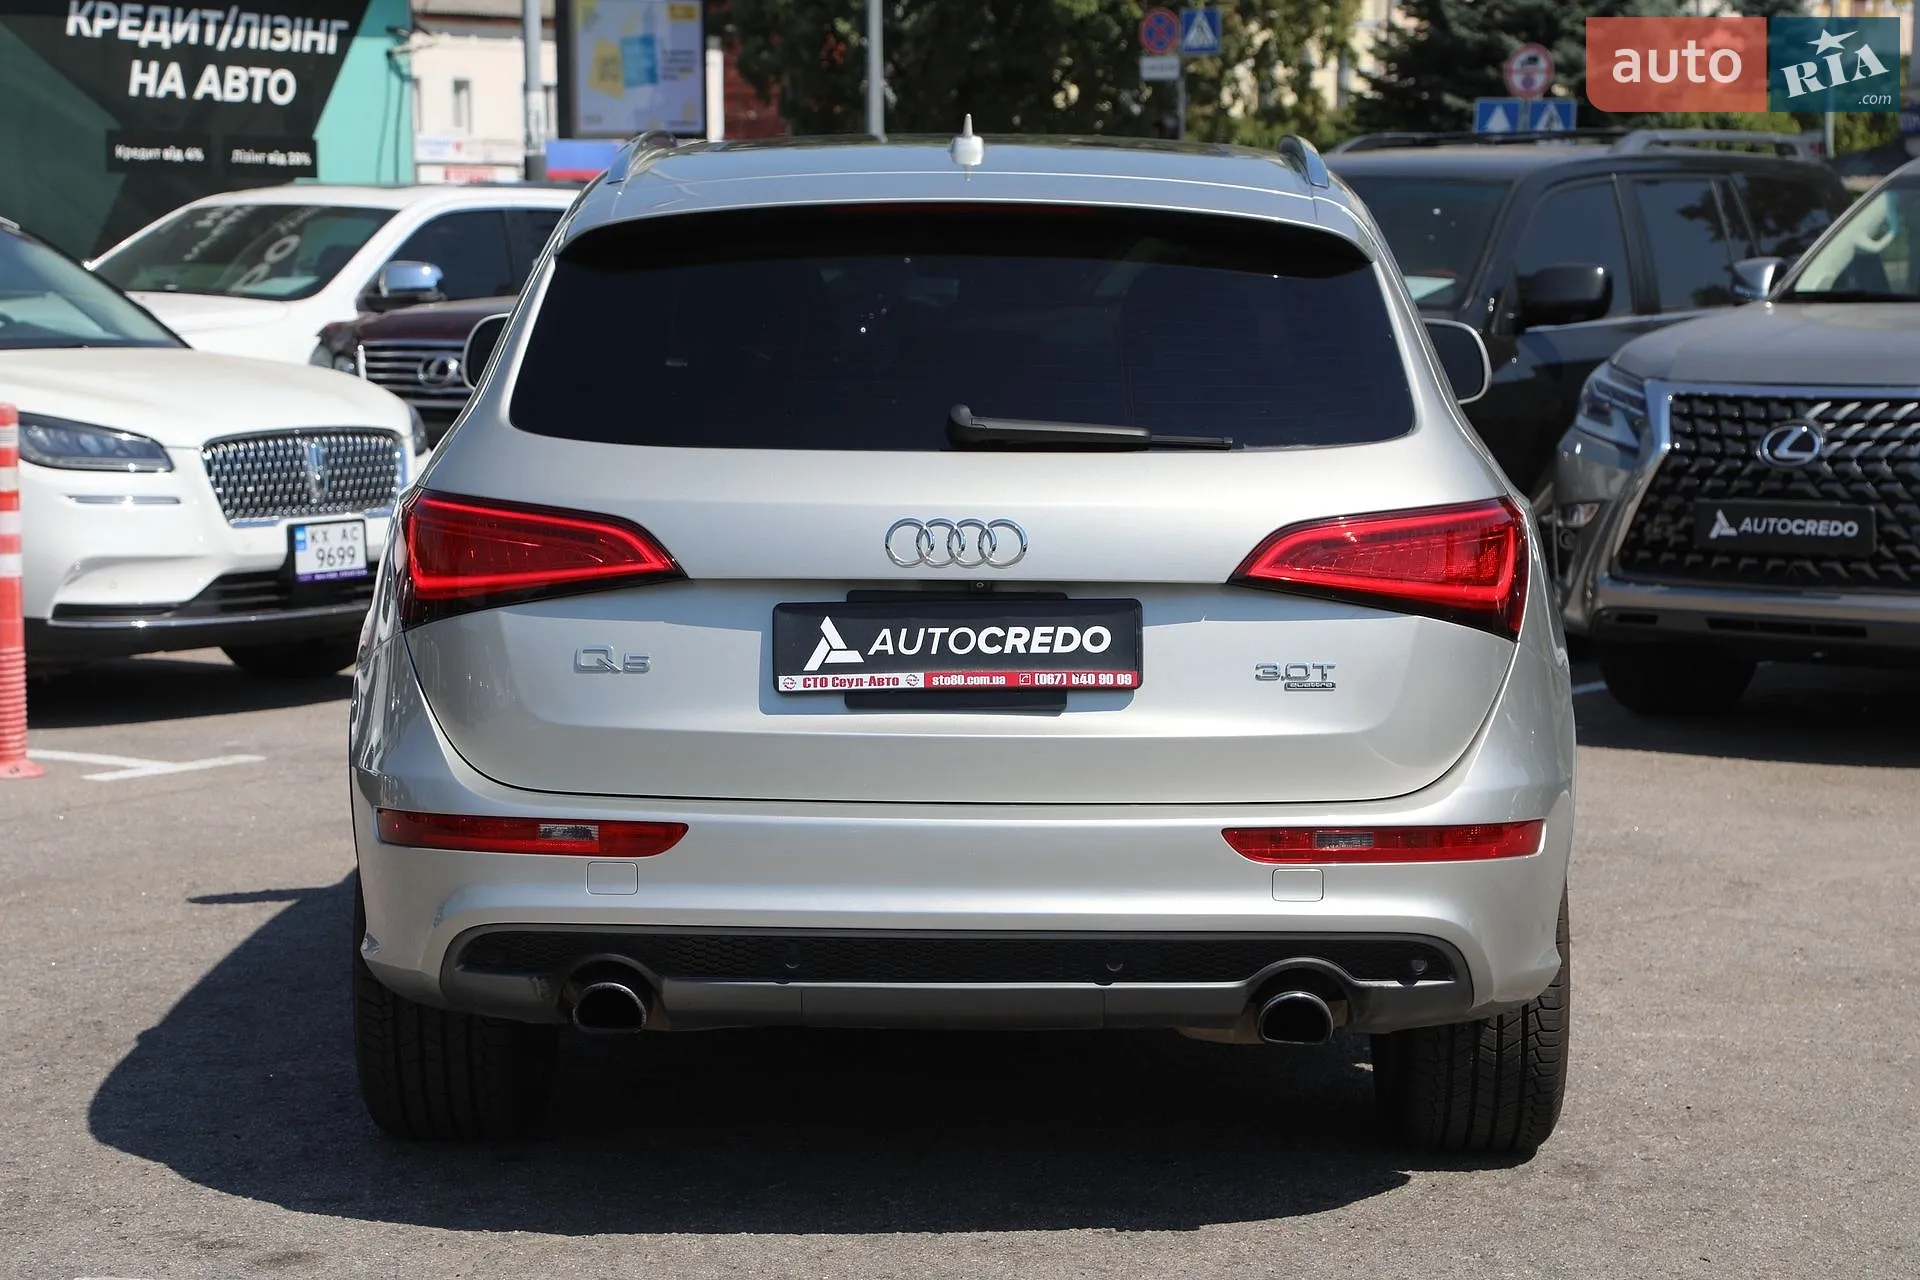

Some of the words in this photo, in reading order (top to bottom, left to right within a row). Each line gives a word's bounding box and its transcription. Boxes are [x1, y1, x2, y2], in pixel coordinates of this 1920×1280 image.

[65, 0, 350, 55] КРЕДИТ/ЛІЗІНГ
[128, 58, 187, 100] НА
[192, 63, 298, 106] АВТО
[115, 144, 161, 161] Кредит
[1739, 516, 1859, 538] AUTOCREDO
[316, 545, 356, 568] 9699
[867, 625, 1112, 656] AUTOCREDO
[574, 645, 650, 674] Q5
[802, 676, 829, 689] СТО
[831, 675, 900, 688] Сеул-Авто
[932, 674, 1005, 686] sto80.com.ua
[1034, 673, 1066, 686] (067)
[1071, 673, 1096, 685] 640
[1098, 673, 1115, 685] 90
[1116, 673, 1133, 685] 09
[1255, 662, 1336, 681] 3.0T
